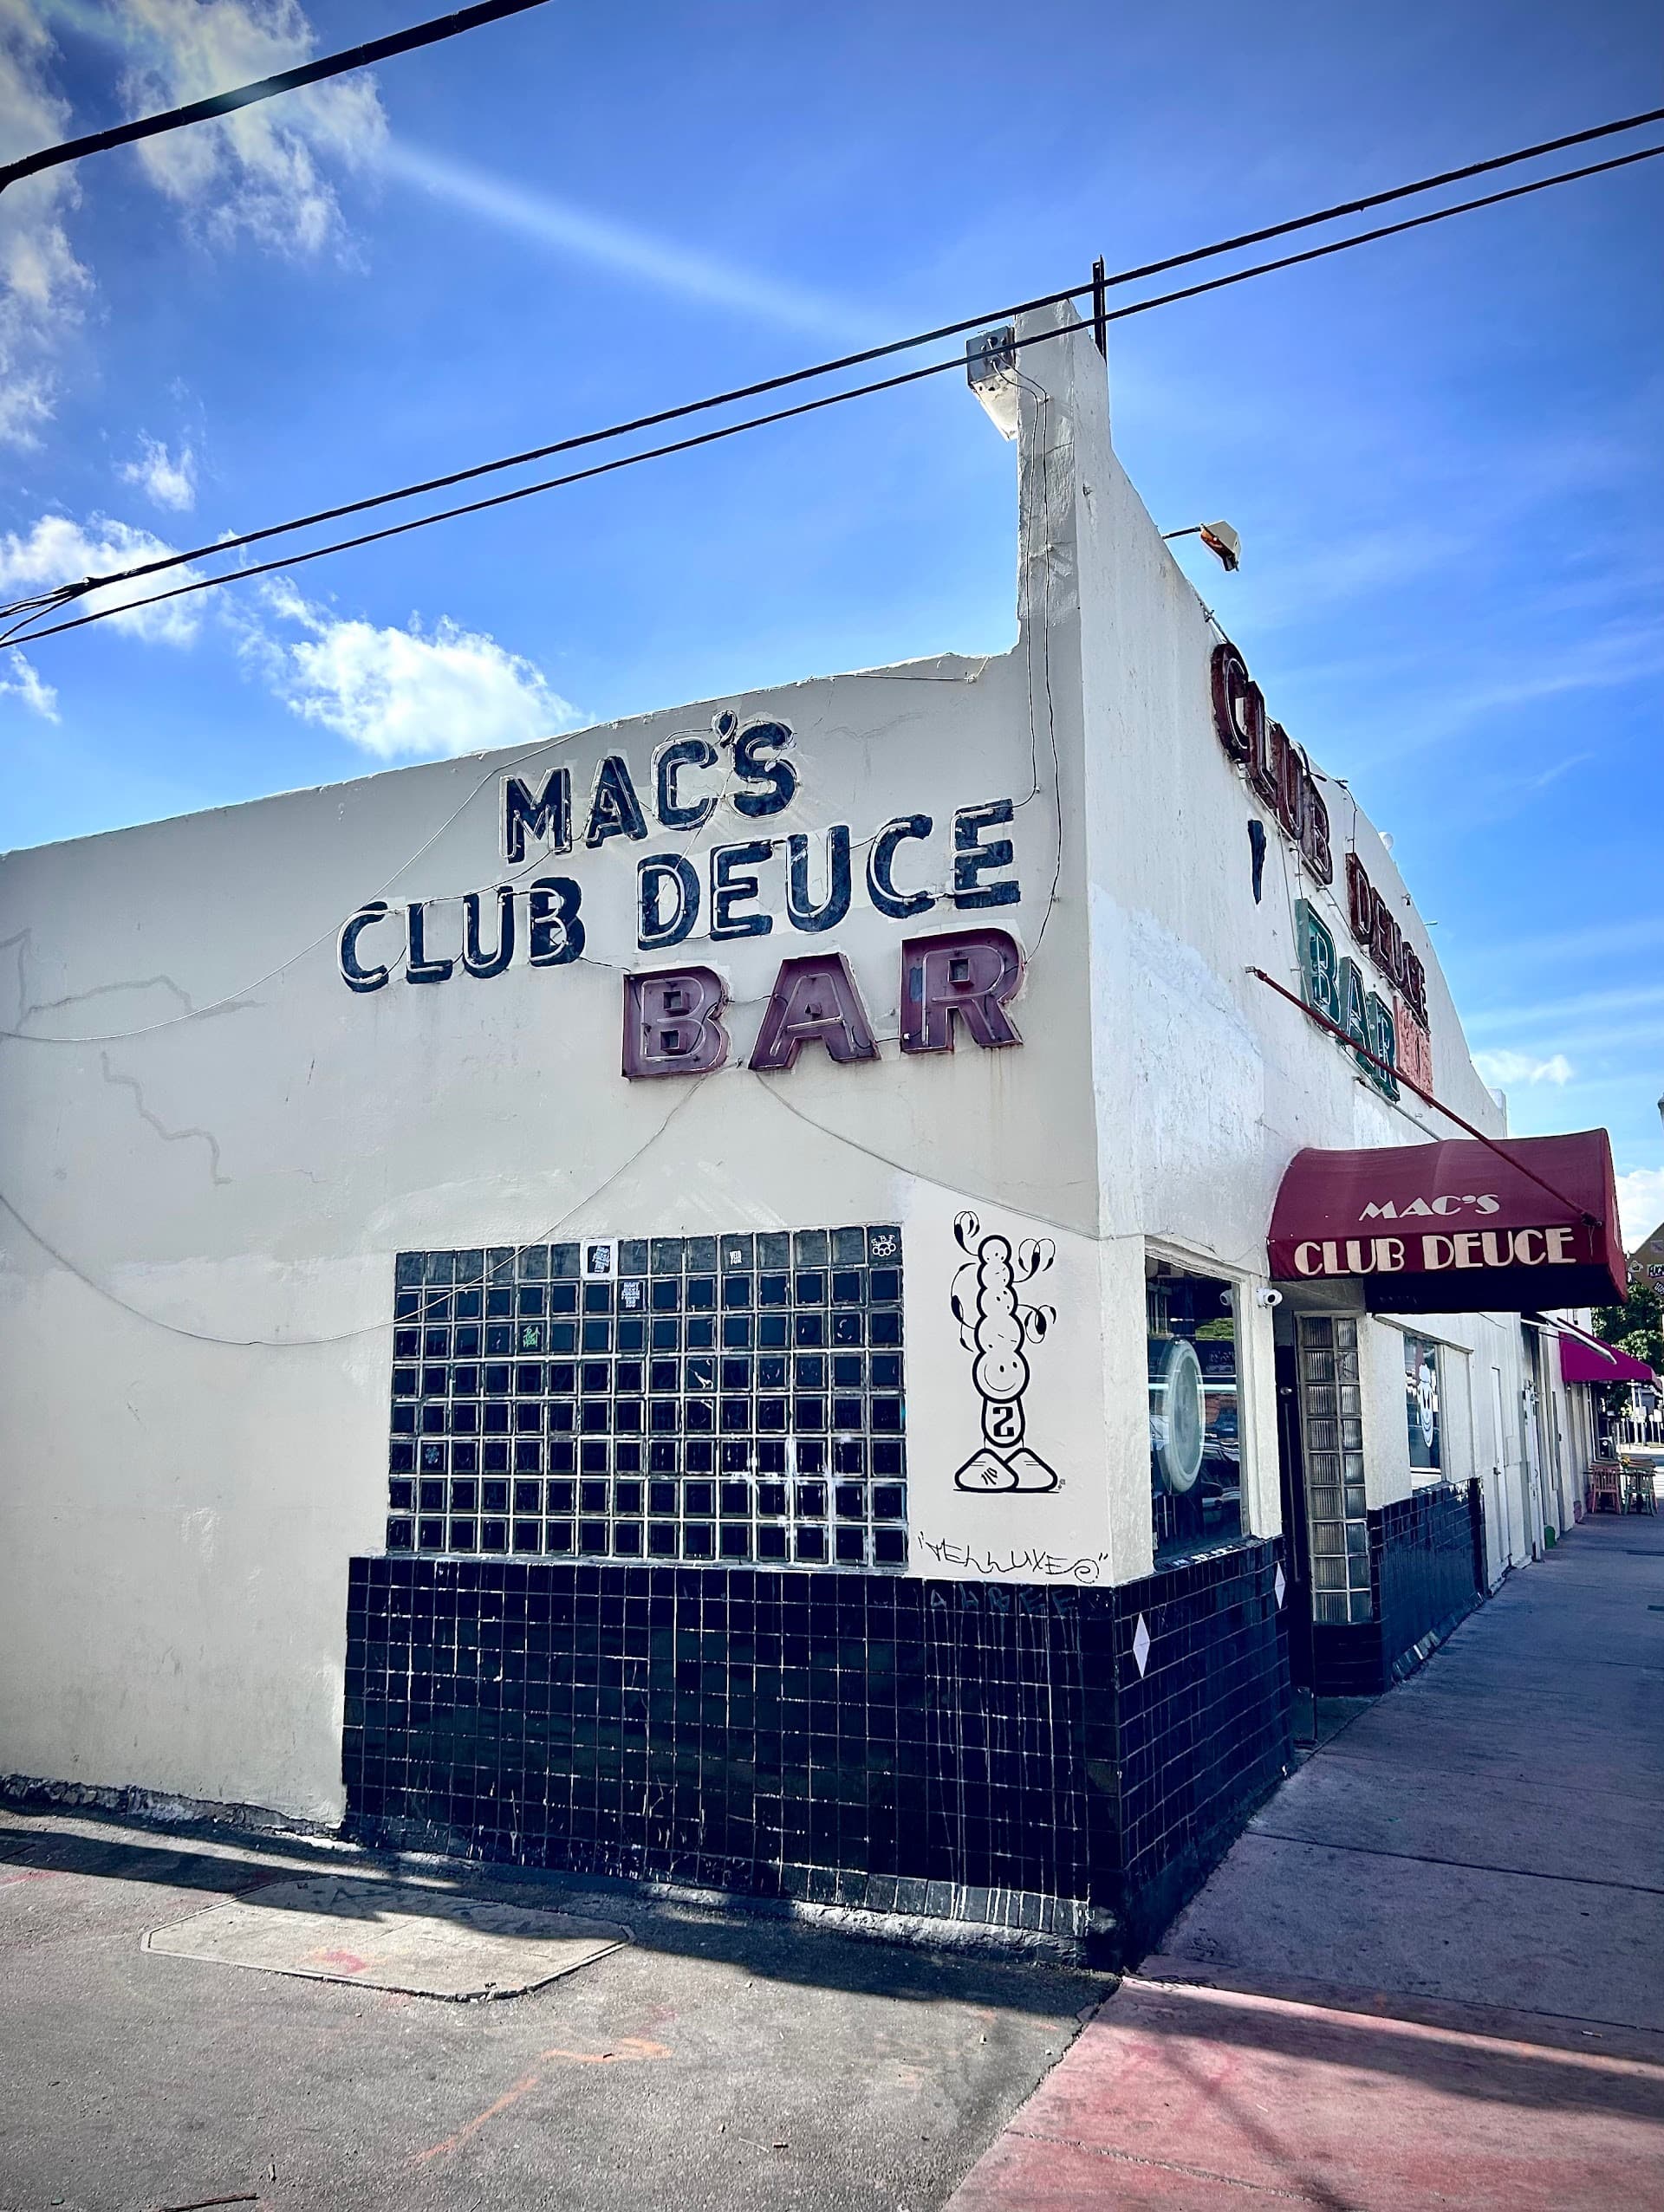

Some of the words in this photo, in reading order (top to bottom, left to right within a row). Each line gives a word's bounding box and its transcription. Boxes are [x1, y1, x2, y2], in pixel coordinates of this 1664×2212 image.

[497, 710, 799, 864] MAC'S
[1212, 643, 1333, 885] CLUB
[337, 876, 586, 993] CLUB
[637, 798, 1021, 950] DEUCE
[621, 927, 1026, 1080] BAR
[1295, 898, 1401, 1103] BAR
[1294, 1238, 1406, 1275] CLUB
[1422, 1228, 1576, 1269] DEUCE
[1358, 1194, 1500, 1221] MAC'S
[992, 1406, 1015, 1437] 2
